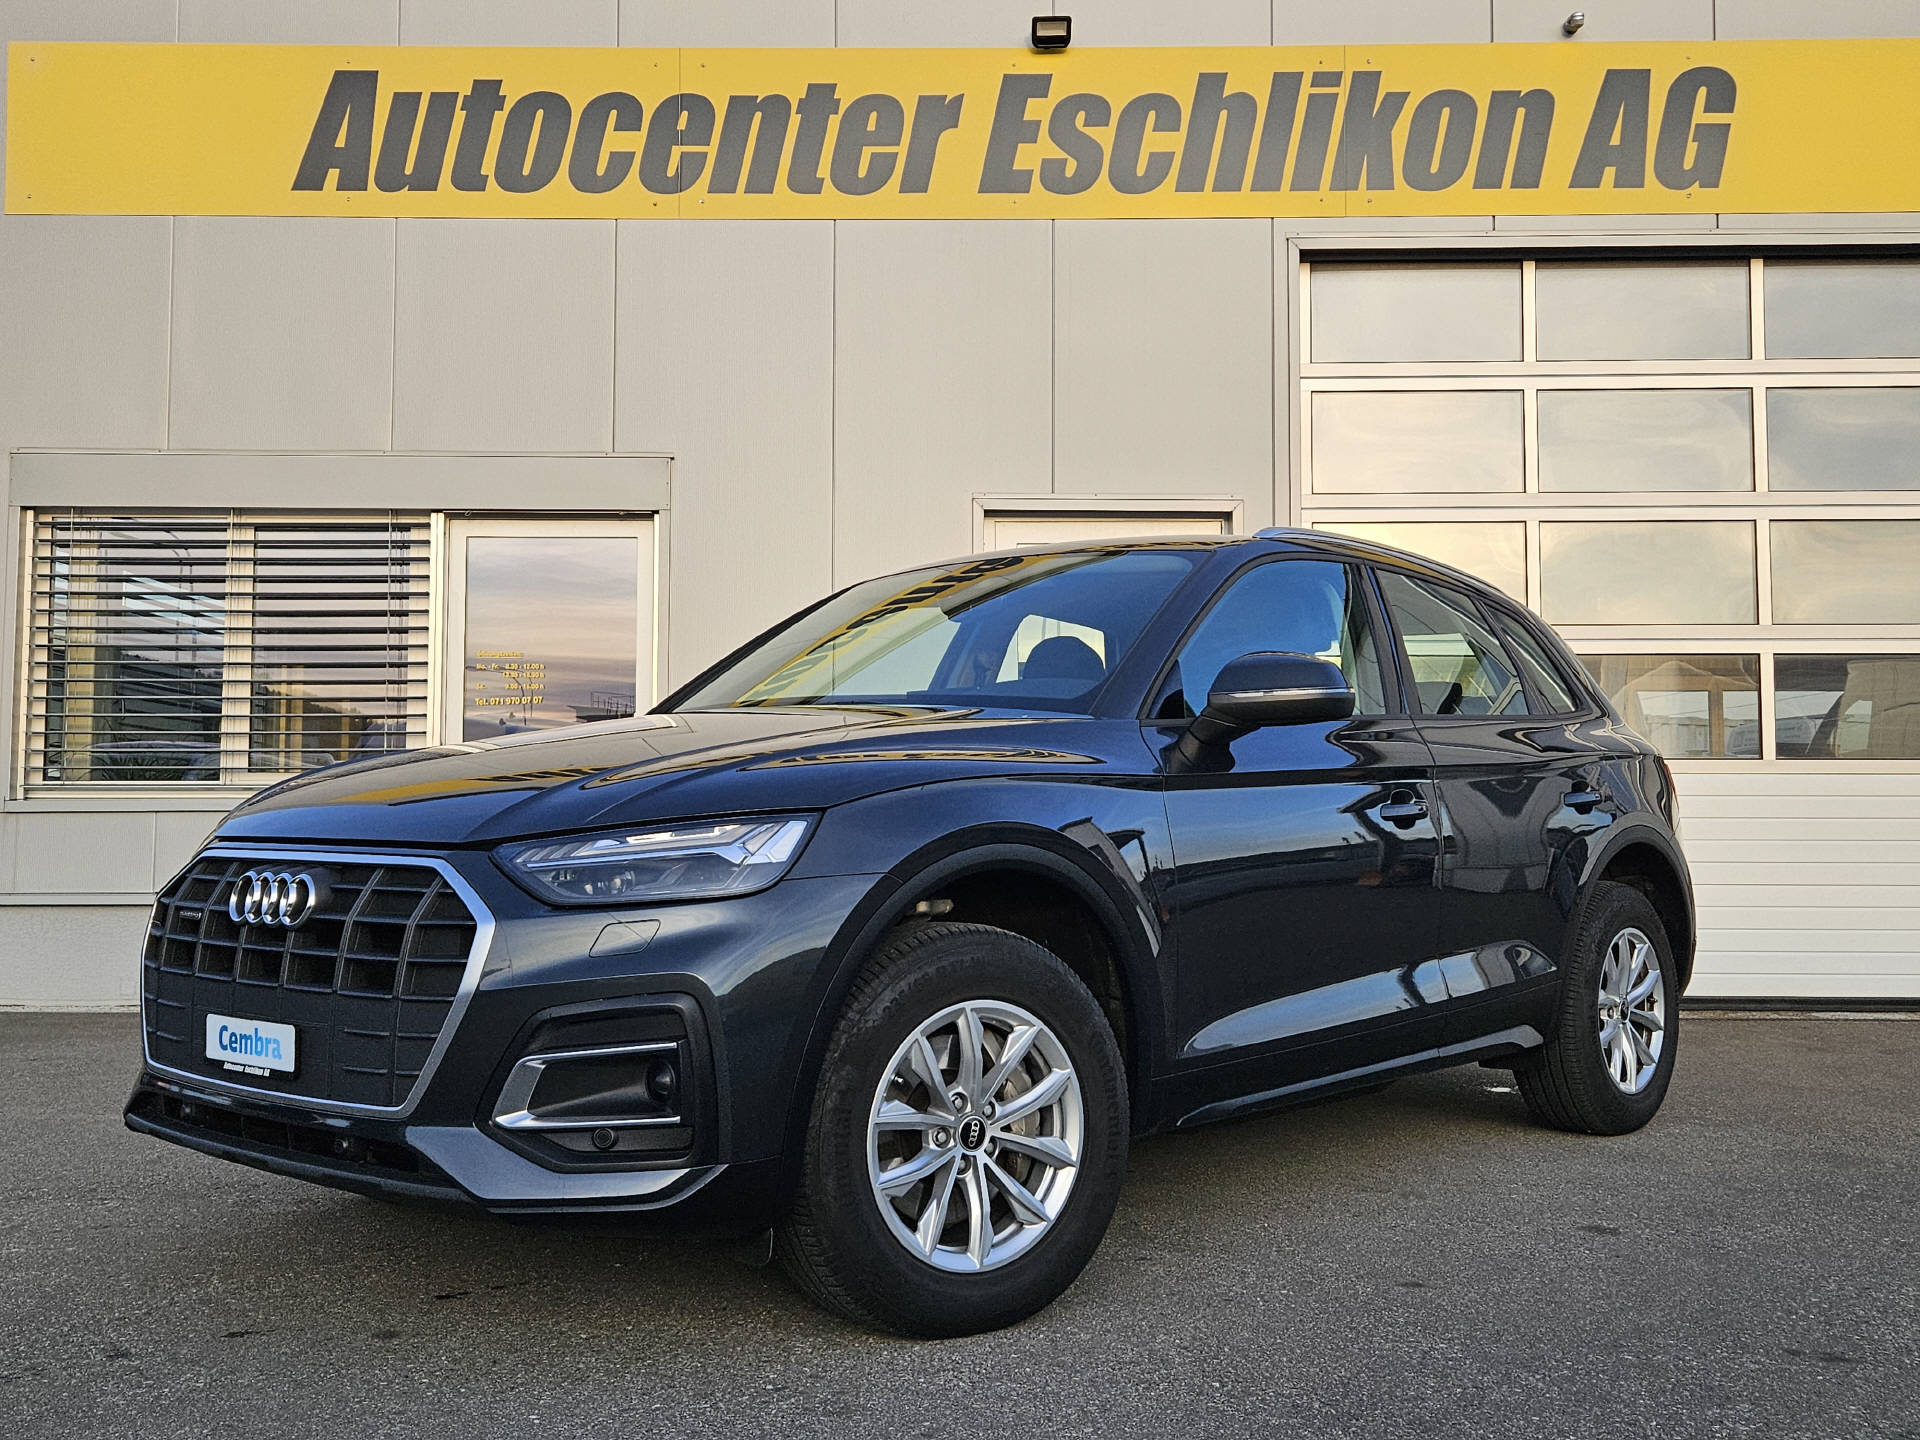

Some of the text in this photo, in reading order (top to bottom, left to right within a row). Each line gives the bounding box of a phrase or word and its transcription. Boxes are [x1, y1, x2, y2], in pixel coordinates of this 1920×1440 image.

[291, 66, 1738, 195] Autocenter Eschlikon AG
[475, 698, 488, 706] Tel.
[490, 697, 504, 705] 071
[533, 696, 544, 704] 07
[218, 1024, 282, 1060] Cembra
